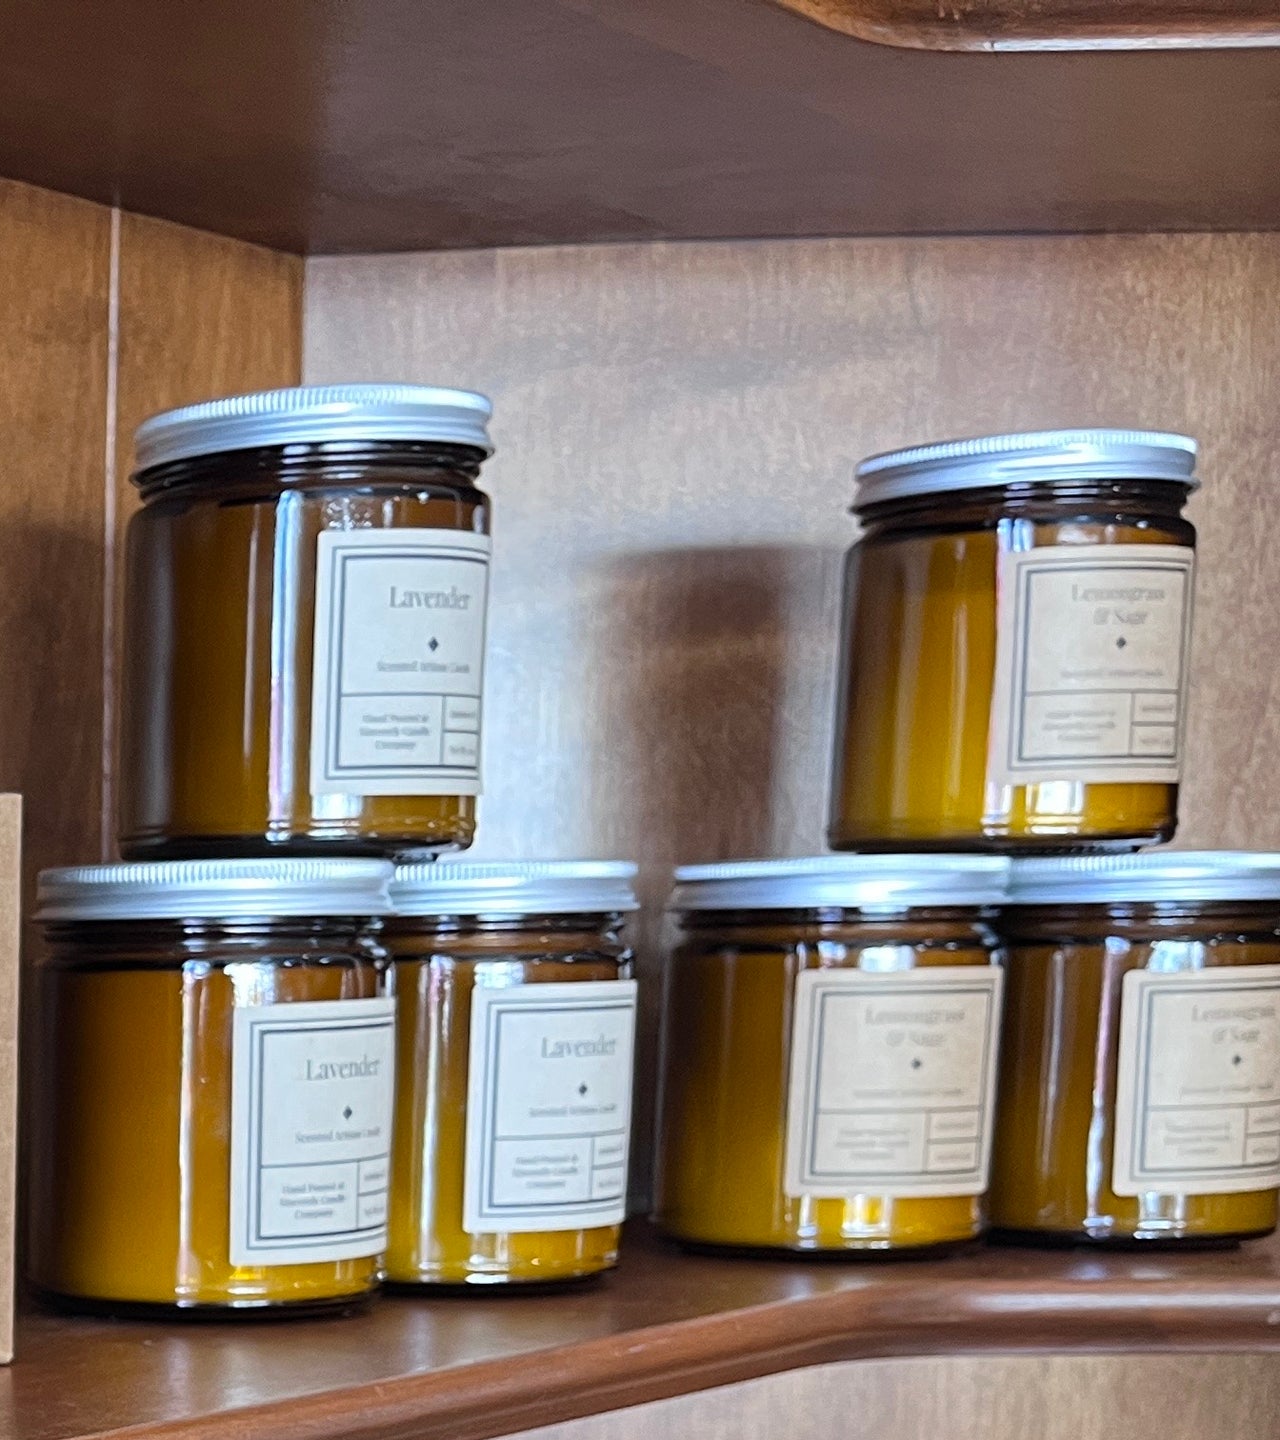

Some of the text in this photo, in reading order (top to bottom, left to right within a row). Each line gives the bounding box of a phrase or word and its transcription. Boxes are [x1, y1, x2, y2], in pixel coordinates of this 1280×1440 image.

[390, 586, 471, 610] Lavender
[540, 1033, 617, 1059] Lavender
[306, 1055, 380, 1081] Lavender
